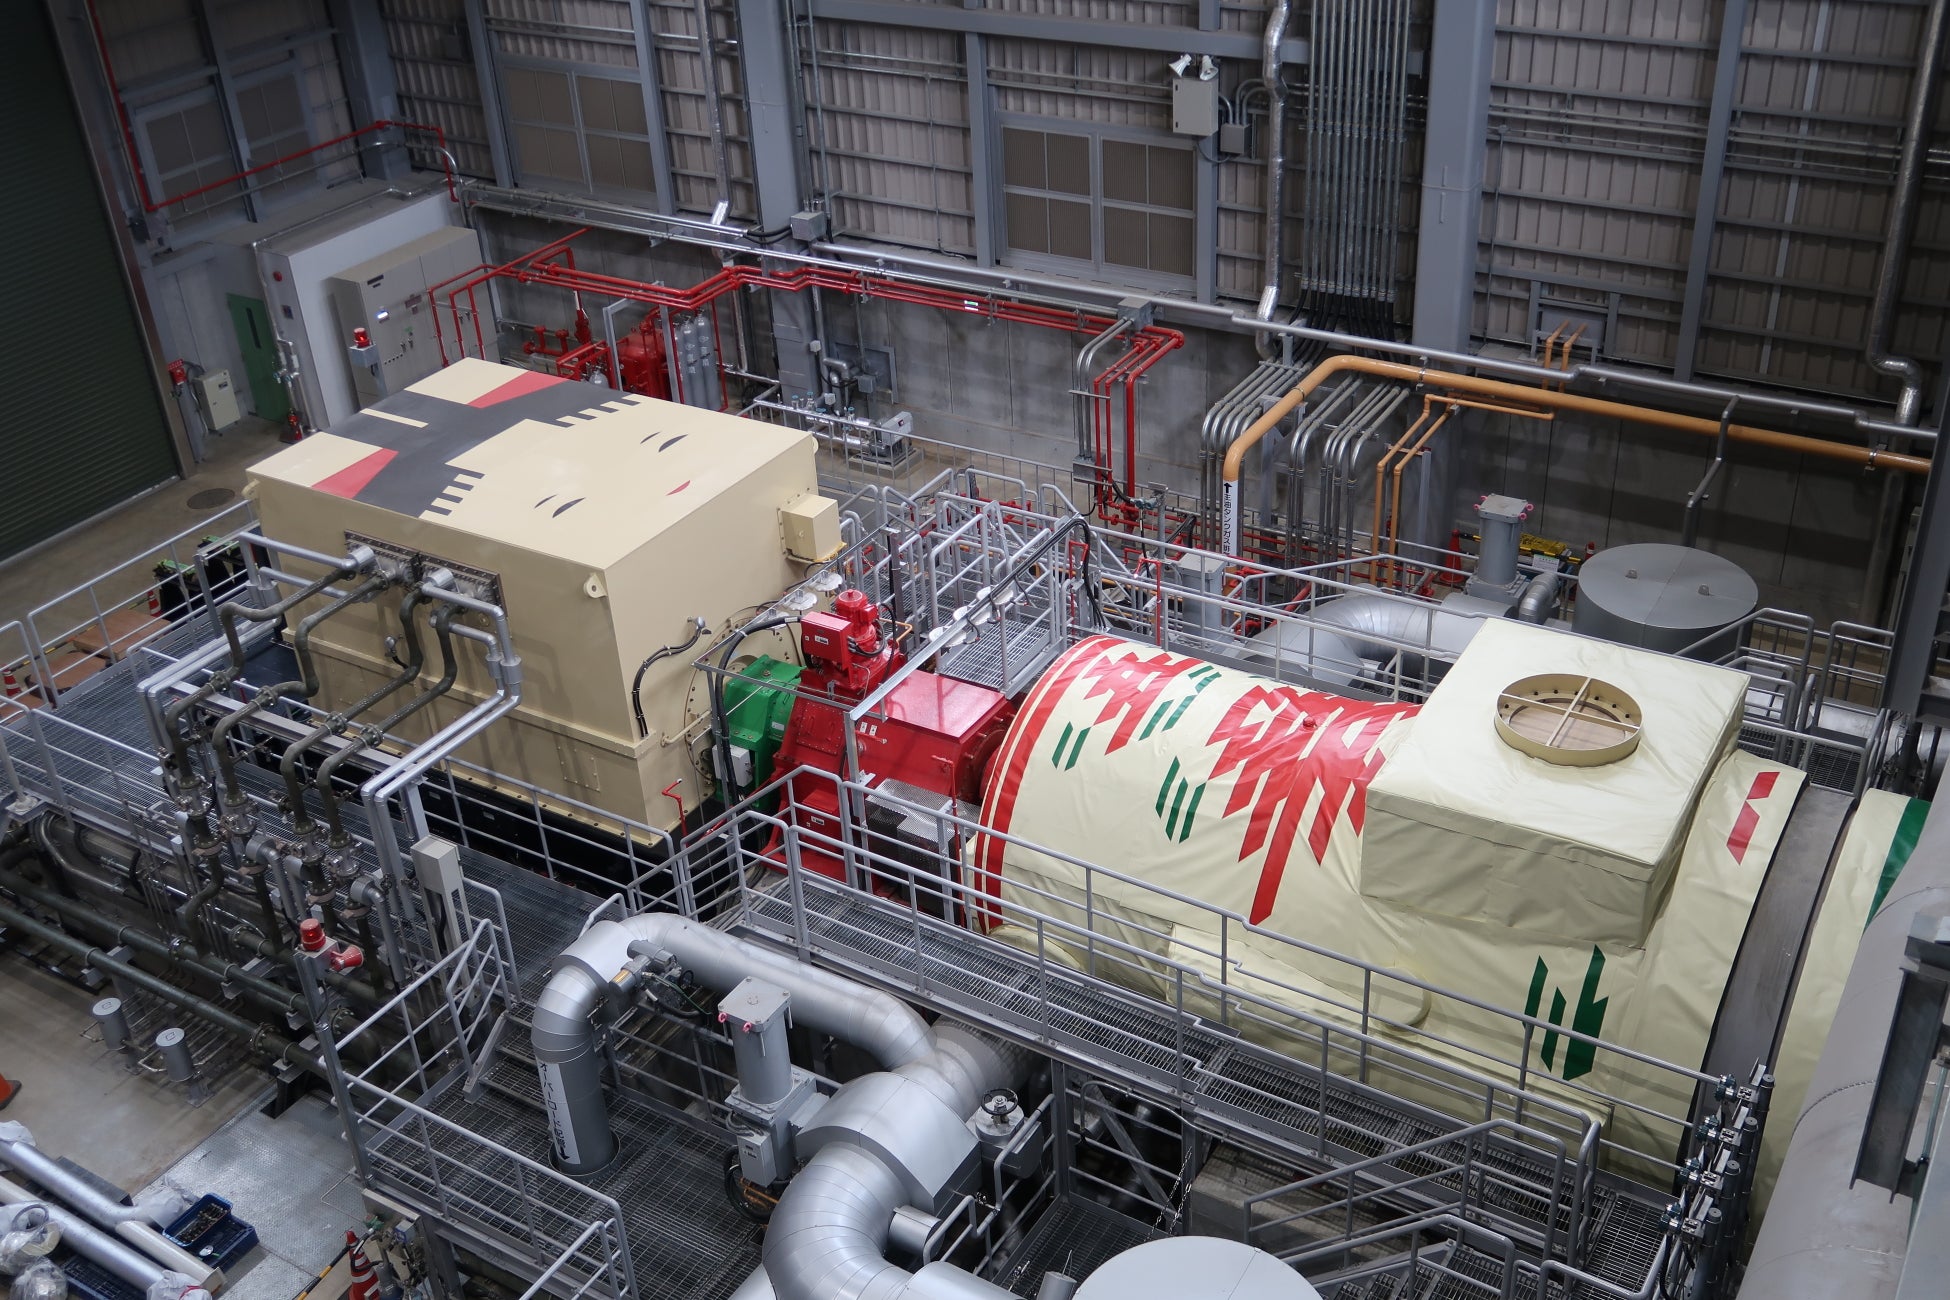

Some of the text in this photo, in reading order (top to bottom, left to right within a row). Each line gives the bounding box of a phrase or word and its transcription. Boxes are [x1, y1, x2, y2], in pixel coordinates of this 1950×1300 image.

[1223, 493, 1231, 566] 主油タンクガス排
